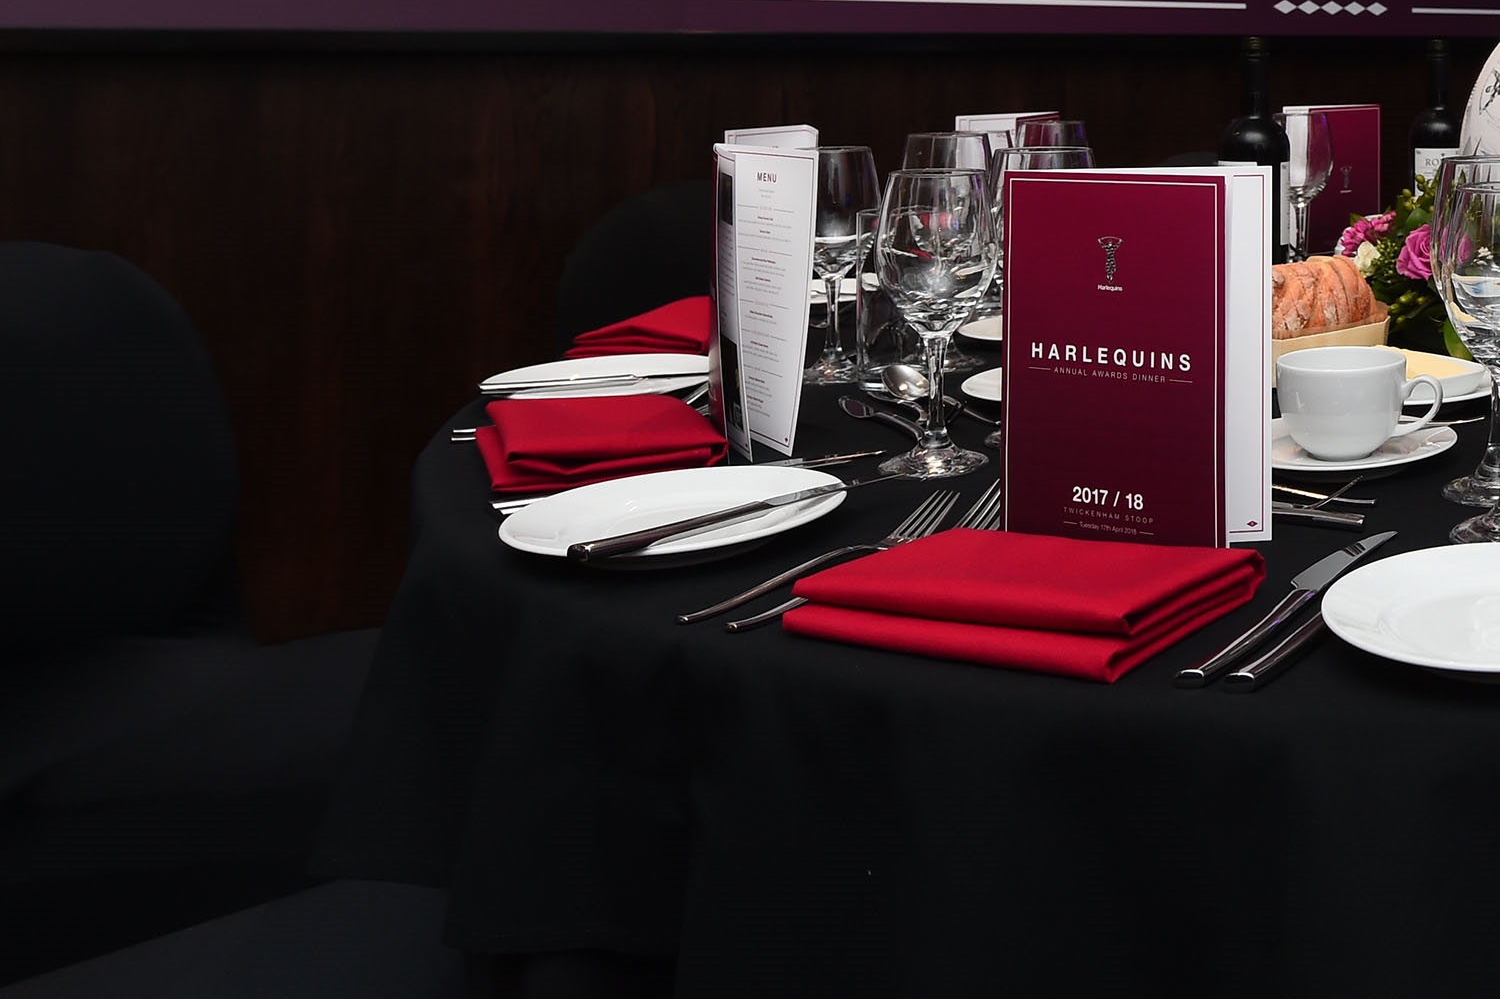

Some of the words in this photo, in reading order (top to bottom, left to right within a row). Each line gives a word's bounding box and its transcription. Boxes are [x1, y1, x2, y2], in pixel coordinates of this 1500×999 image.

[756, 171, 777, 183] MENU
[1031, 341, 1192, 372] HARLEQUINS
[1053, 366, 1088, 377] ANNUAL
[1091, 369, 1128, 381] AWARDS
[1132, 373, 1166, 384] DINNER
[1072, 485, 1109, 506] 2017
[1113, 490, 1120, 507] /
[1125, 492, 1144, 510] 18
[1063, 506, 1120, 520] TWICKENHAM
[1124, 514, 1154, 524] STOOP
